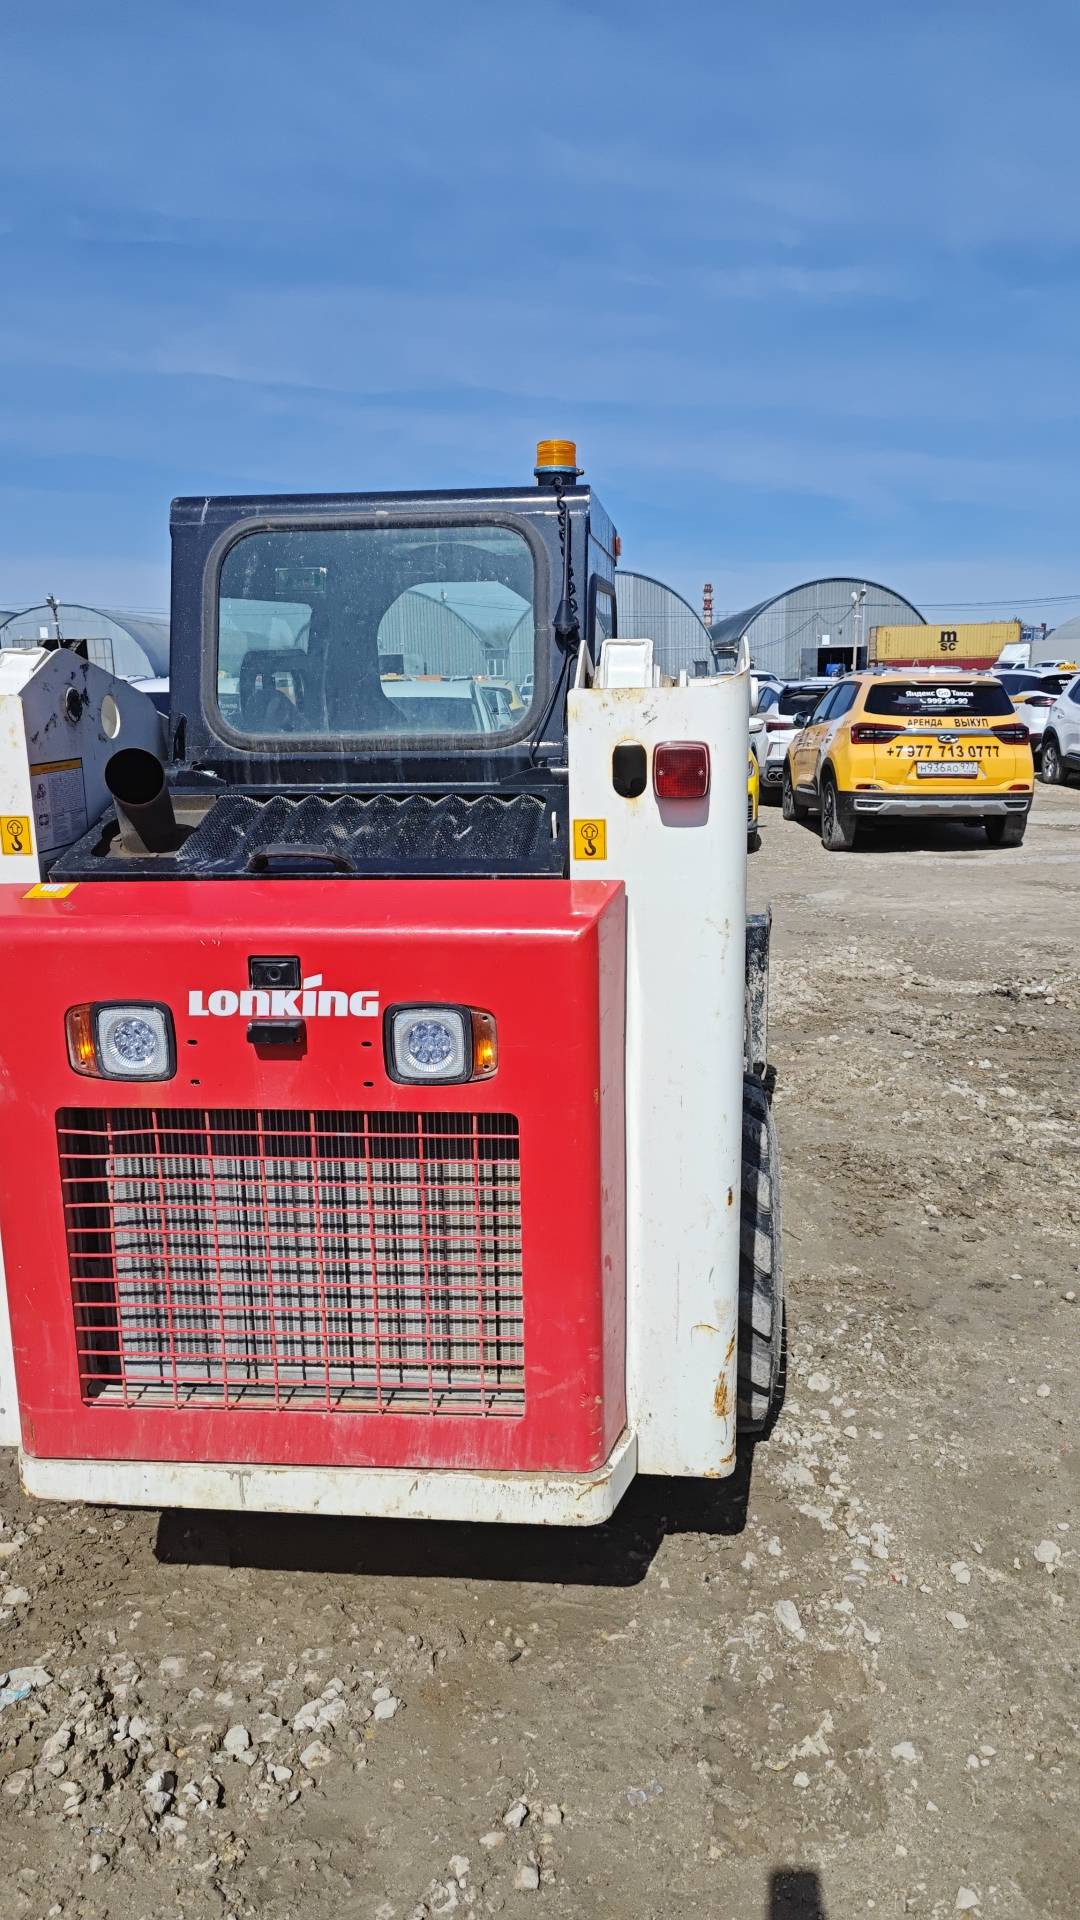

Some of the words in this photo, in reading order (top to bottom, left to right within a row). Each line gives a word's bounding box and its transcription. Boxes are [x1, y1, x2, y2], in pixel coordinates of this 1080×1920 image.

[905, 690, 935, 698] Яндекс
[951, 689, 974, 697] Такси
[927, 697, 968, 705] 999-99-99
[907, 718, 943, 727] АРЕНДА
[954, 718, 989, 728] ВЫКУП
[886, 745, 904, 758] +7
[906, 745, 933, 758] 977
[938, 745, 965, 758] 713
[967, 745, 1000, 758] 0777
